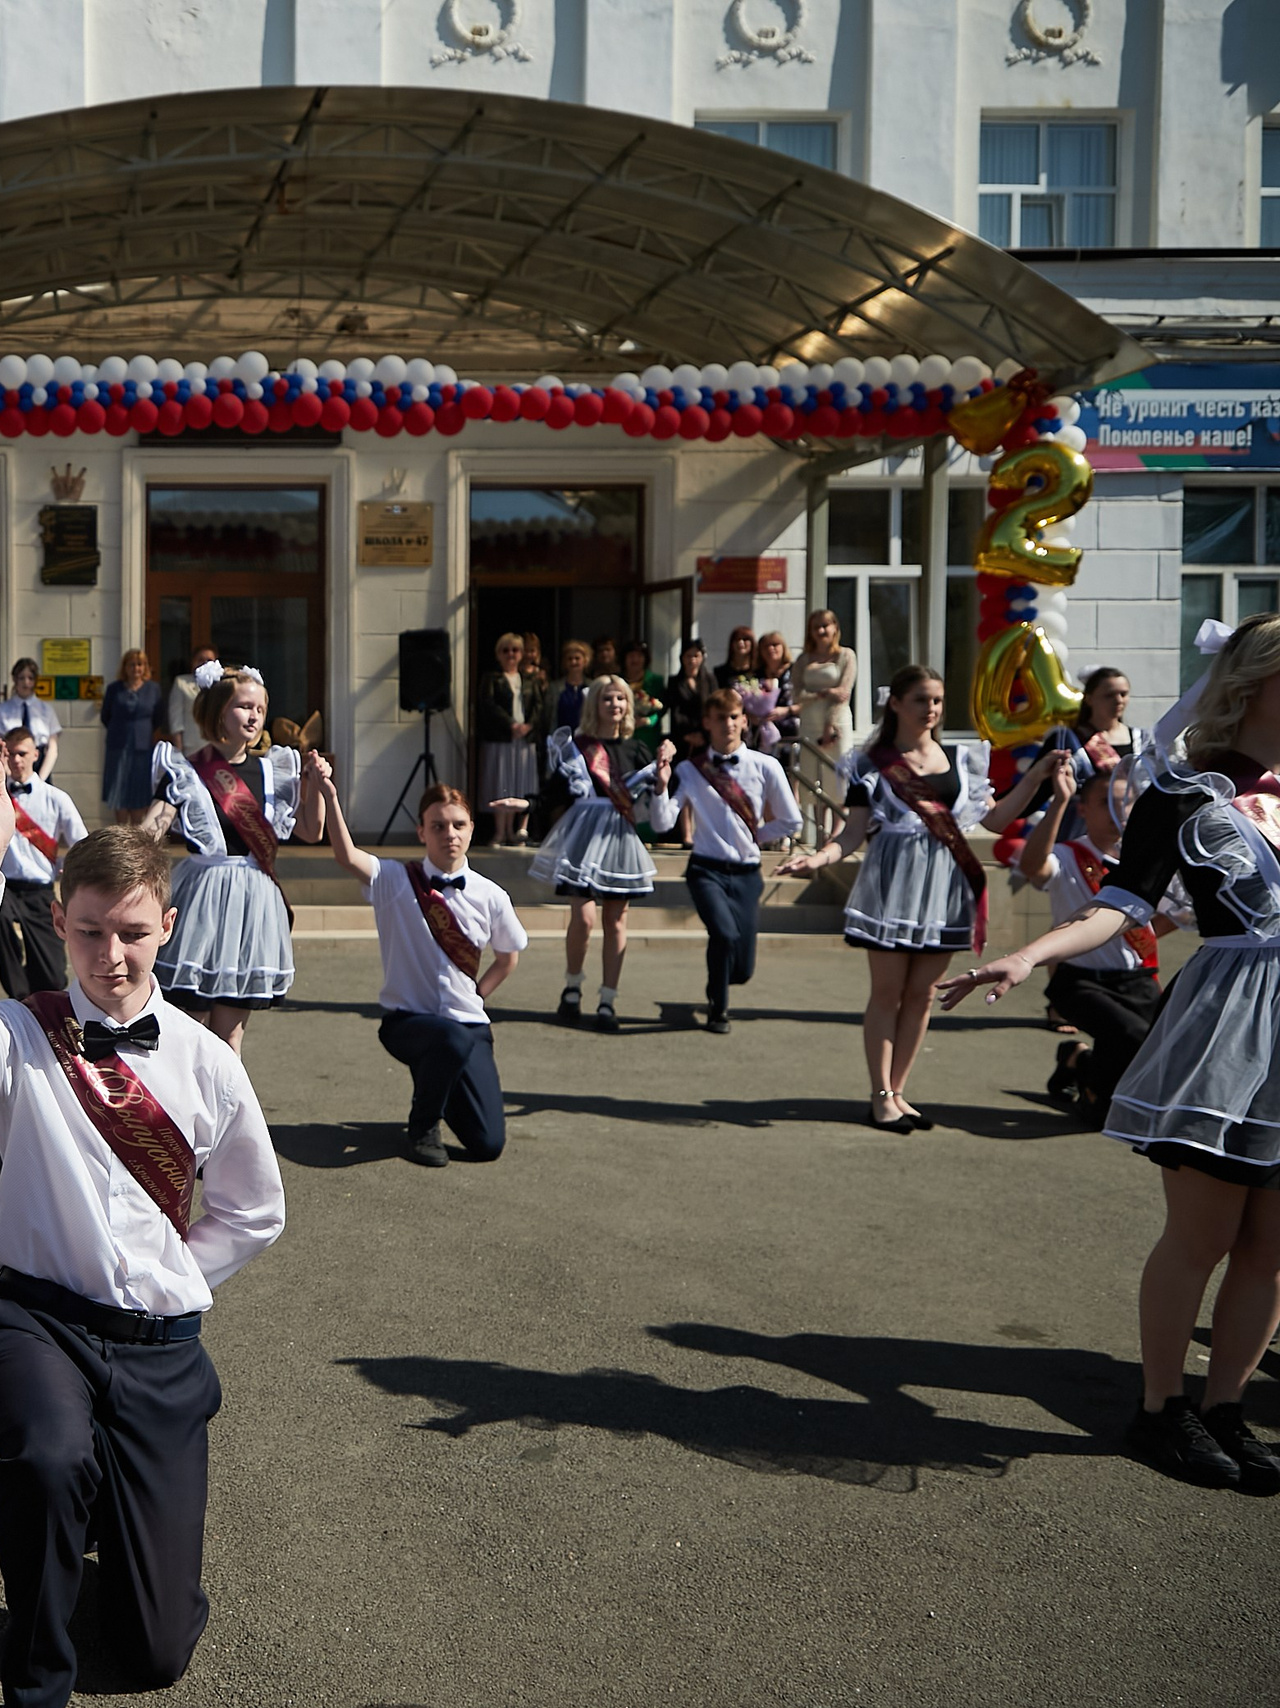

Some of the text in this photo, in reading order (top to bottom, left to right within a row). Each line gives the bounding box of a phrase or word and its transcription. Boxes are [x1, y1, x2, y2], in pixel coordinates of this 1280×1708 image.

[1098, 396, 1122, 418] Не
[1127, 400, 1190, 423] уронит
[1195, 400, 1246, 418] честь
[1098, 424, 1253, 446] Поколенье наше!
